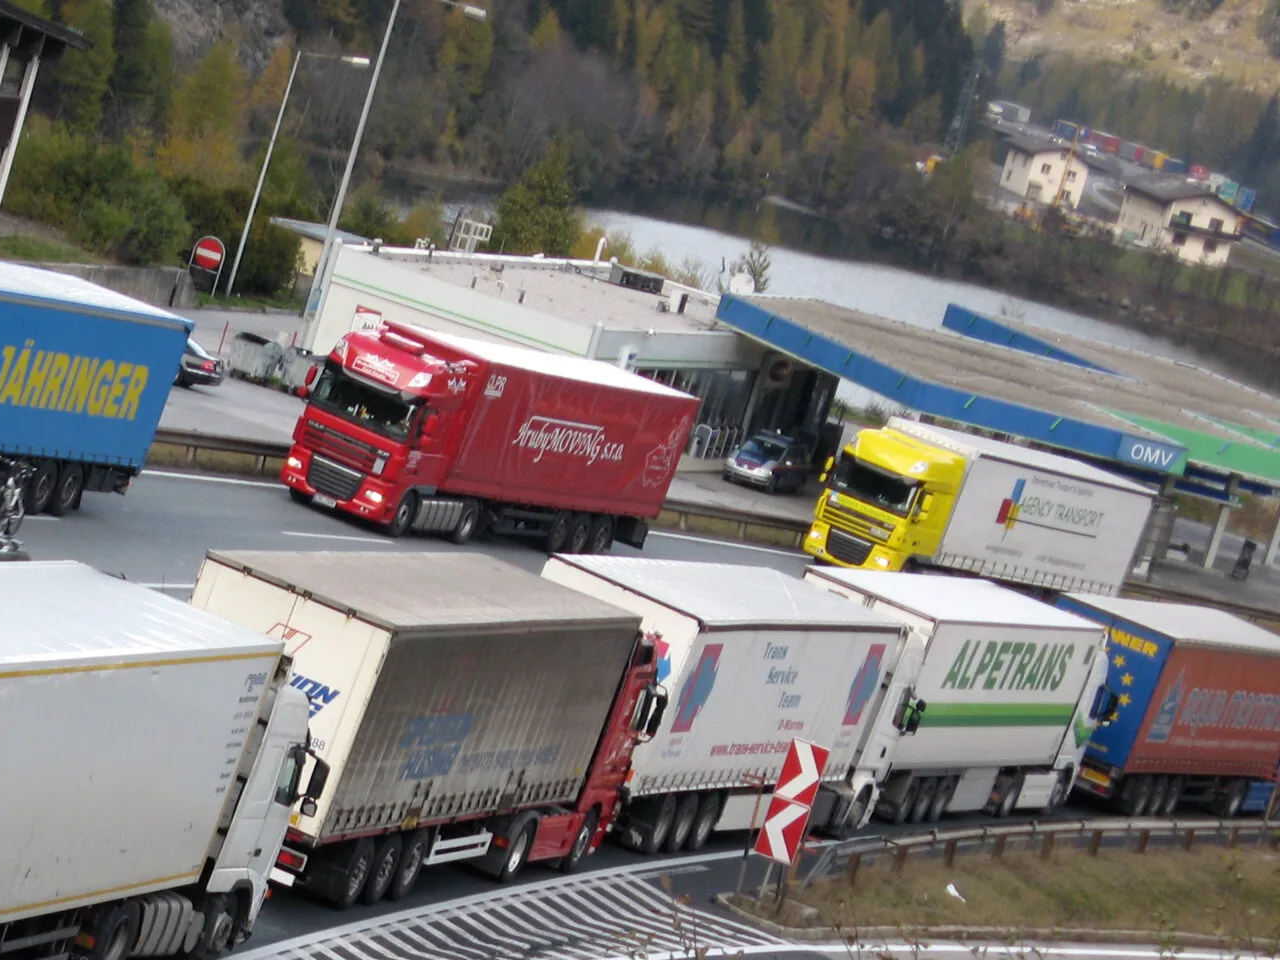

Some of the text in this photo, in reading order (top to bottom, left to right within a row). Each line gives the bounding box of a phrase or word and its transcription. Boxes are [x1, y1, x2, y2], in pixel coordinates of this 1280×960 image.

[1131, 443, 1174, 467] OMV
[764, 642, 790, 661] Trans
[766, 666, 799, 685] Service
[941, 638, 1075, 693] ALPETRANS
[290, 671, 341, 705] ION
[777, 692, 803, 709] Team
